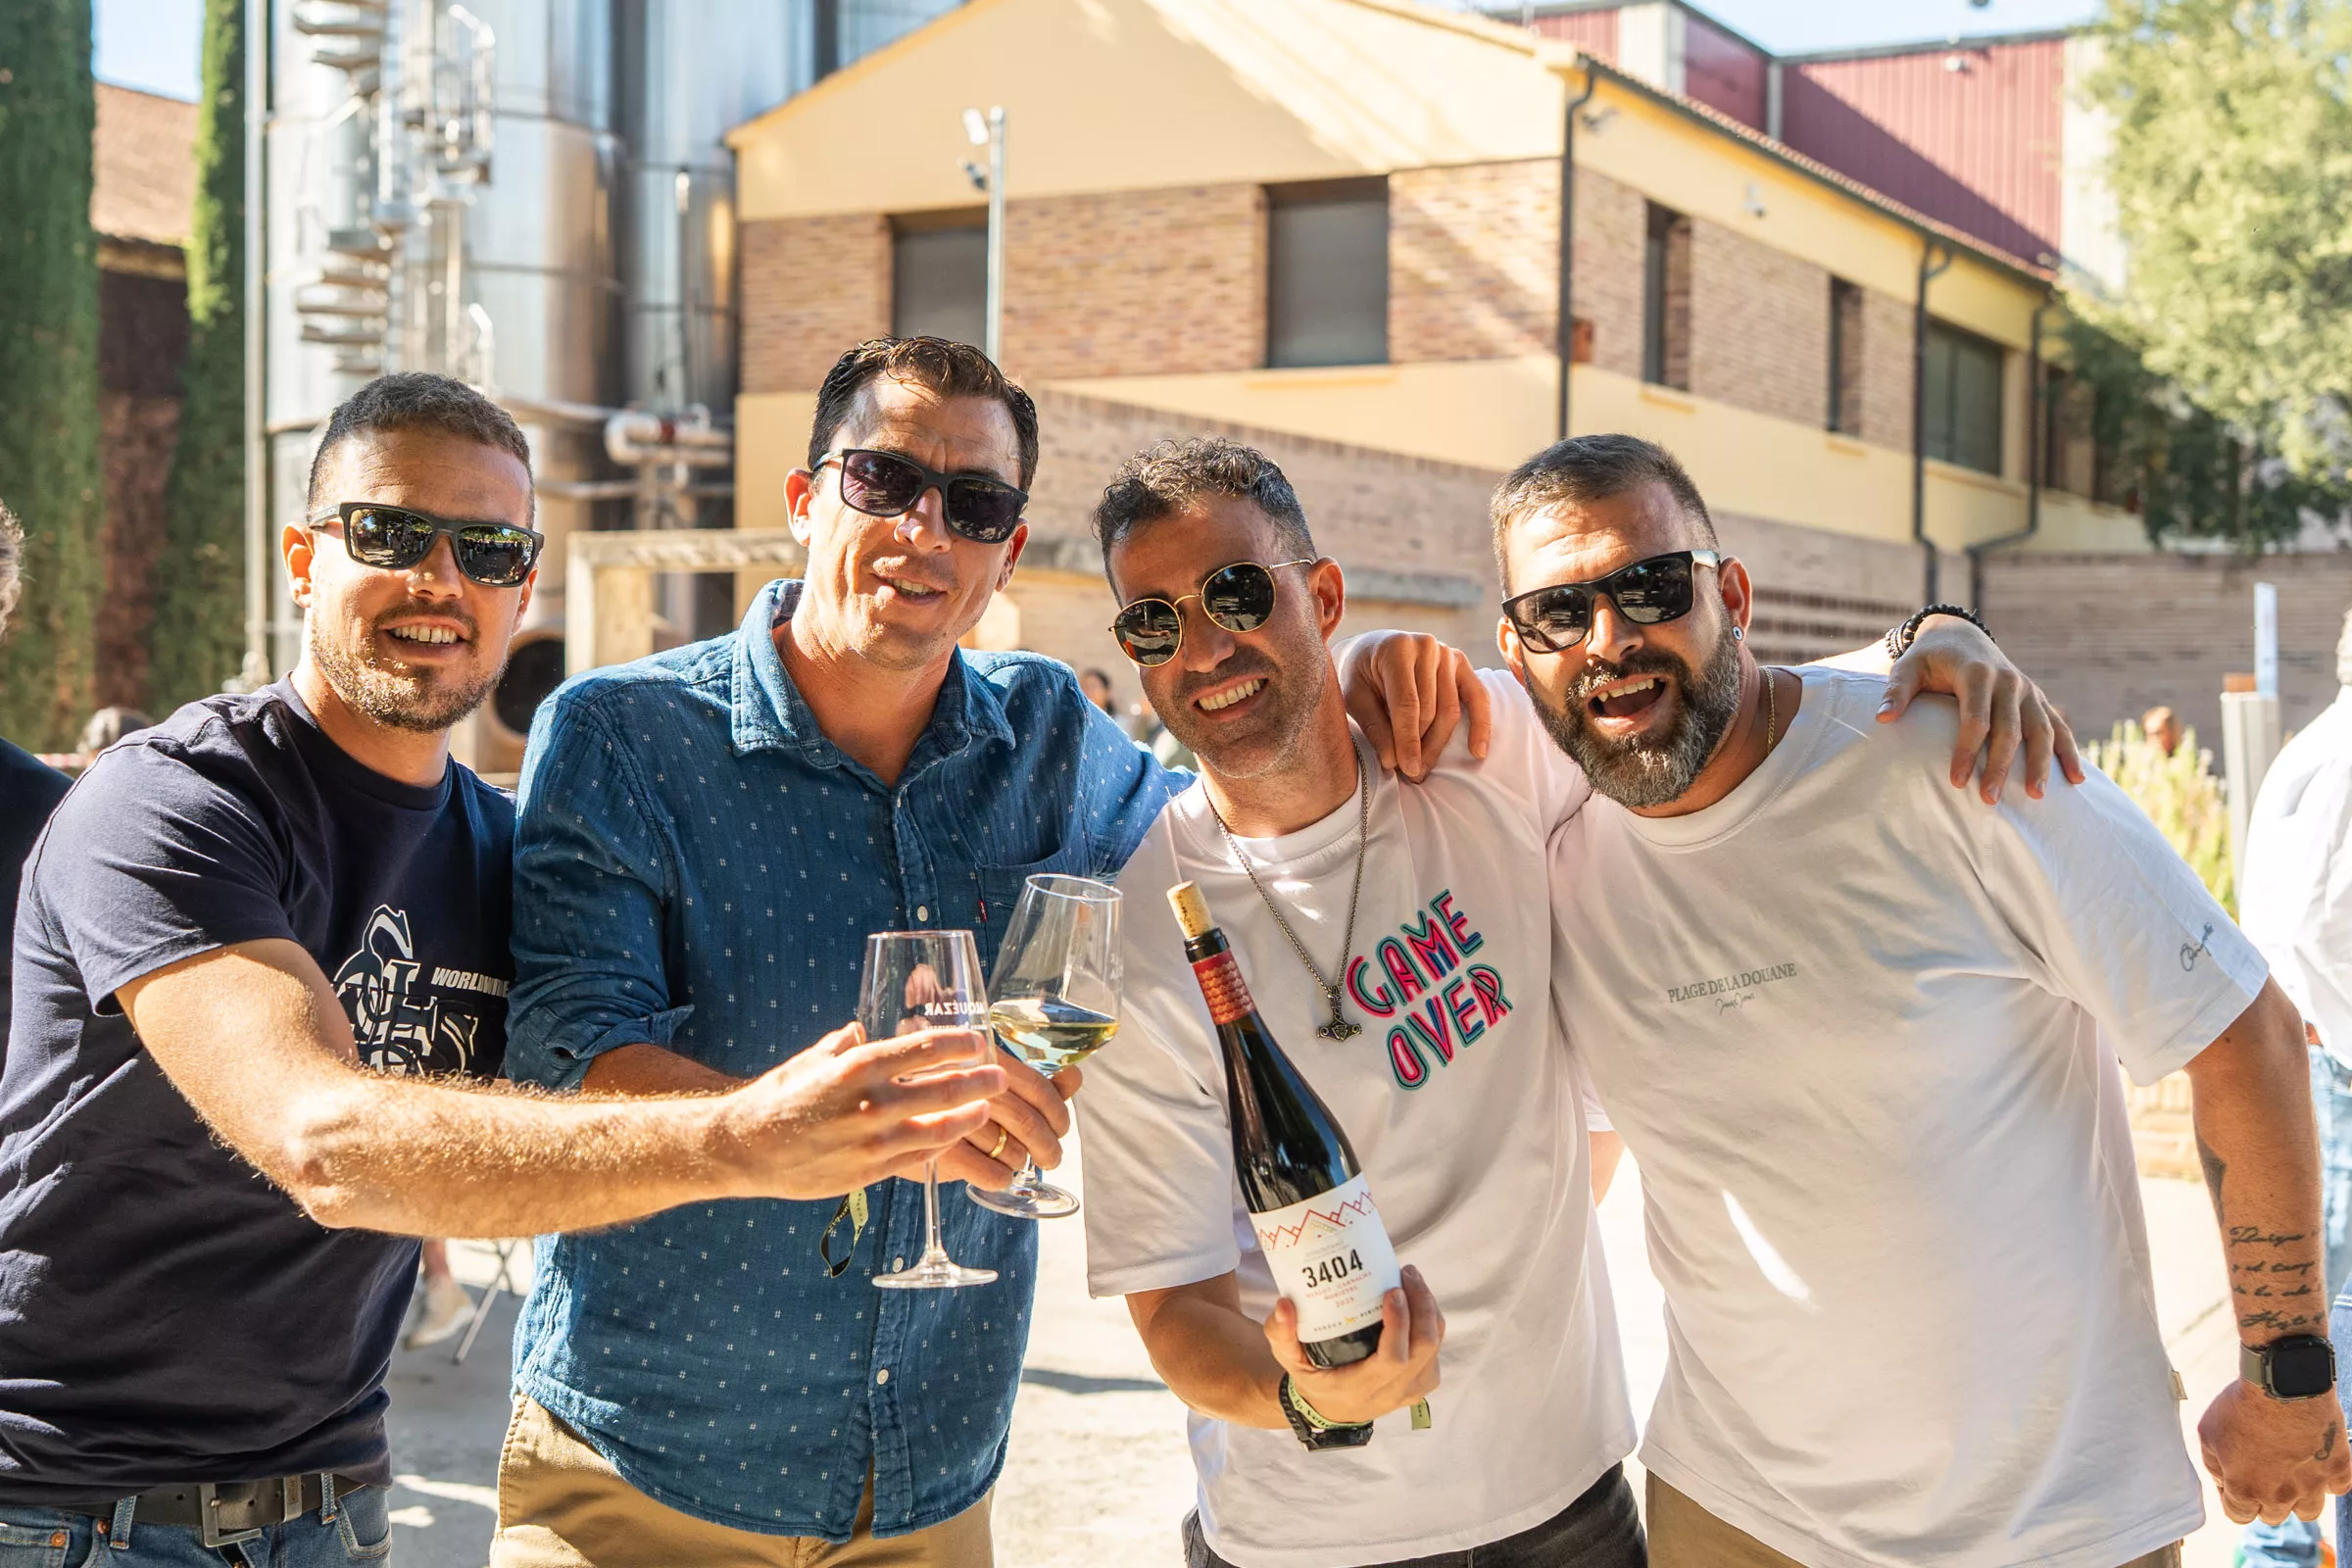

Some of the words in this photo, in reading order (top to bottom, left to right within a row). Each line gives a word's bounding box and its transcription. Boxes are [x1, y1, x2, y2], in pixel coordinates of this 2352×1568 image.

[1346, 888, 1485, 1018] GAME
[1667, 982, 1707, 1004] PLAGE
[1708, 979, 1726, 996] DE
[1725, 975, 1741, 992] LA
[1740, 962, 1797, 988] DOUANE
[1387, 963, 1513, 1092] OVER
[1301, 1248, 1363, 1288] 3404
